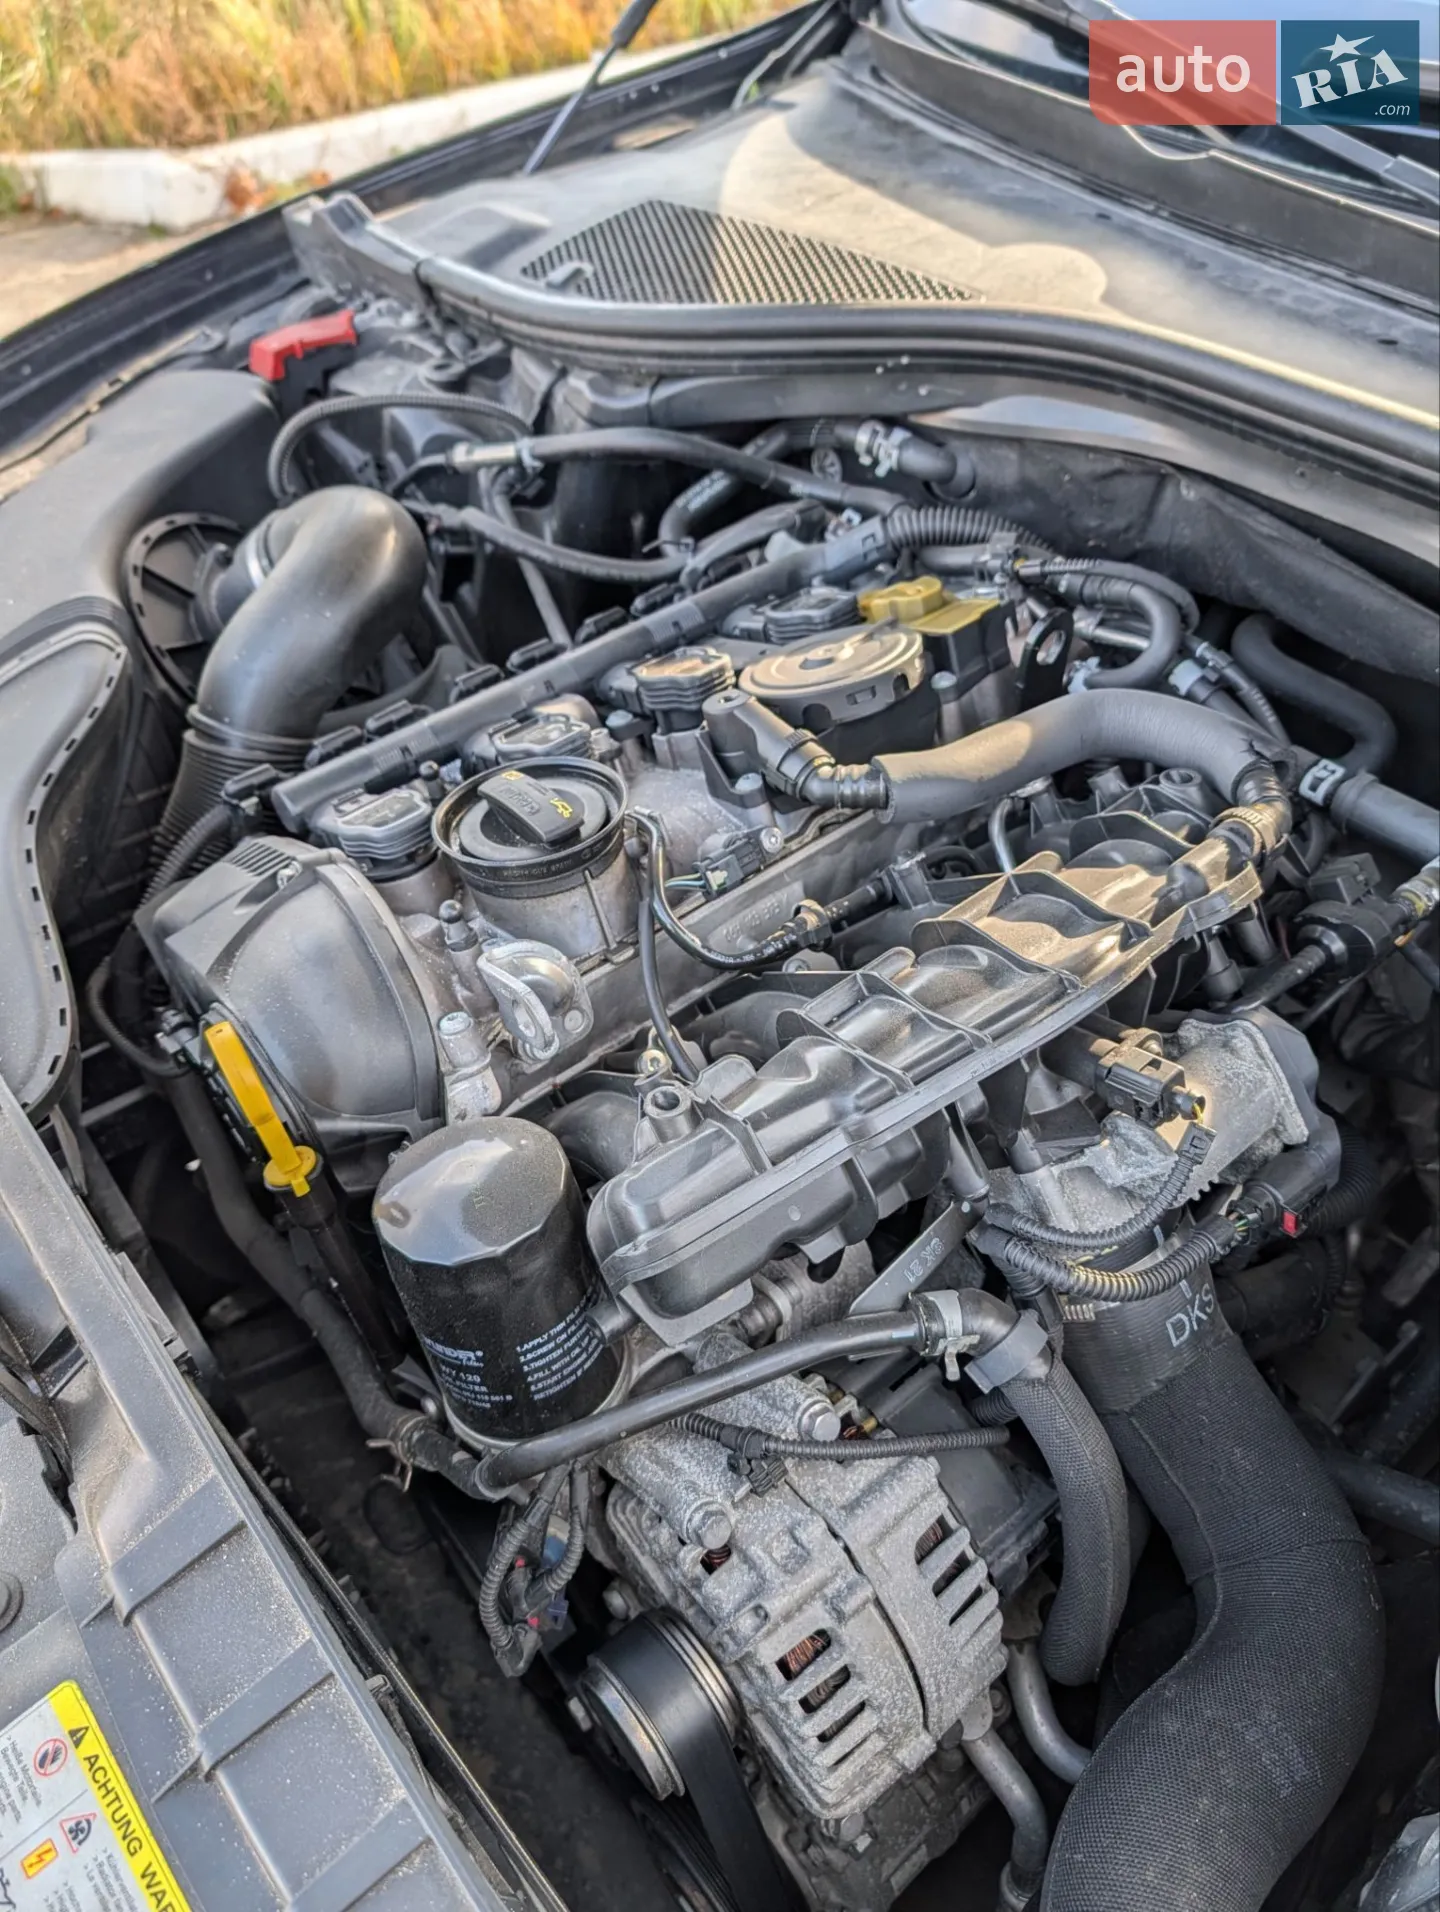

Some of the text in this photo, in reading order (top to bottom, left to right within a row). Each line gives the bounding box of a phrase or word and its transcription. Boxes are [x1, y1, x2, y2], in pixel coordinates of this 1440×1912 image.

[1165, 1283, 1215, 1348] DKS
[515, 1332, 549, 1353] 1.APPLY
[549, 1320, 567, 1337] THIN
[519, 1340, 556, 1363] 2.SCREW
[556, 1332, 568, 1345] ON
[523, 1347, 564, 1373] 3.TIGHTEN
[526, 1367, 552, 1383] 4.FILL
[551, 1355, 571, 1371] WITH
[530, 1372, 563, 1392] 5.START
[533, 1374, 578, 1401] RETIGHTEN
[84, 1753, 143, 1857] ACHTUNG
